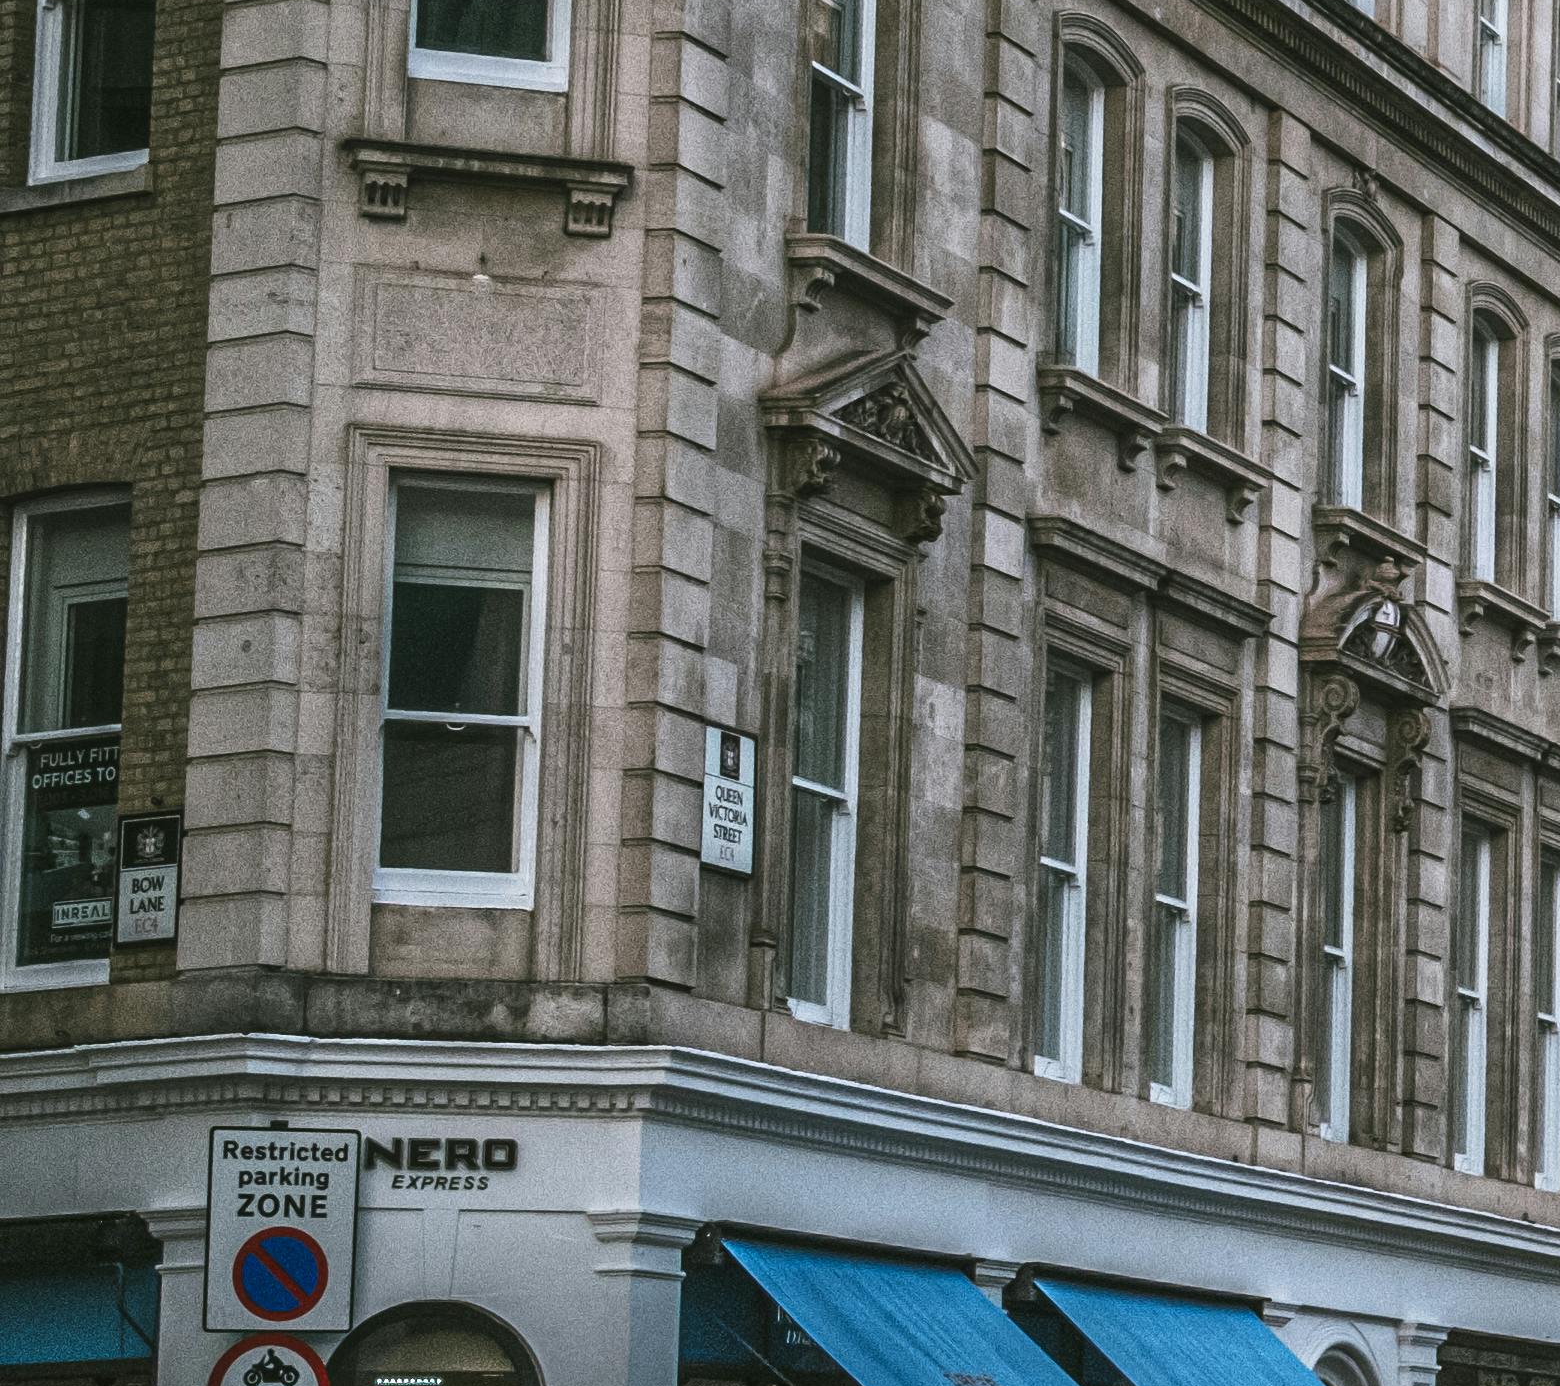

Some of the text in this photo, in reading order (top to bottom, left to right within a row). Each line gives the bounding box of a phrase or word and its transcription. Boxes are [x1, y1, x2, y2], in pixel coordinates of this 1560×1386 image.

[40, 750, 85, 769] FULLY
[32, 765, 117, 790] OFFICES TO
[715, 785, 743, 806] QUEEN
[708, 802, 748, 827] VICTORIA
[713, 824, 743, 844] STREET
[131, 876, 165, 894] BOW
[129, 895, 165, 914] LANE
[222, 1140, 349, 1163] Restricted
[364, 1137, 518, 1172] NERO
[238, 1167, 330, 1190] parking
[391, 1175, 490, 1191] EXPRESS
[237, 1193, 328, 1219] ZONE
